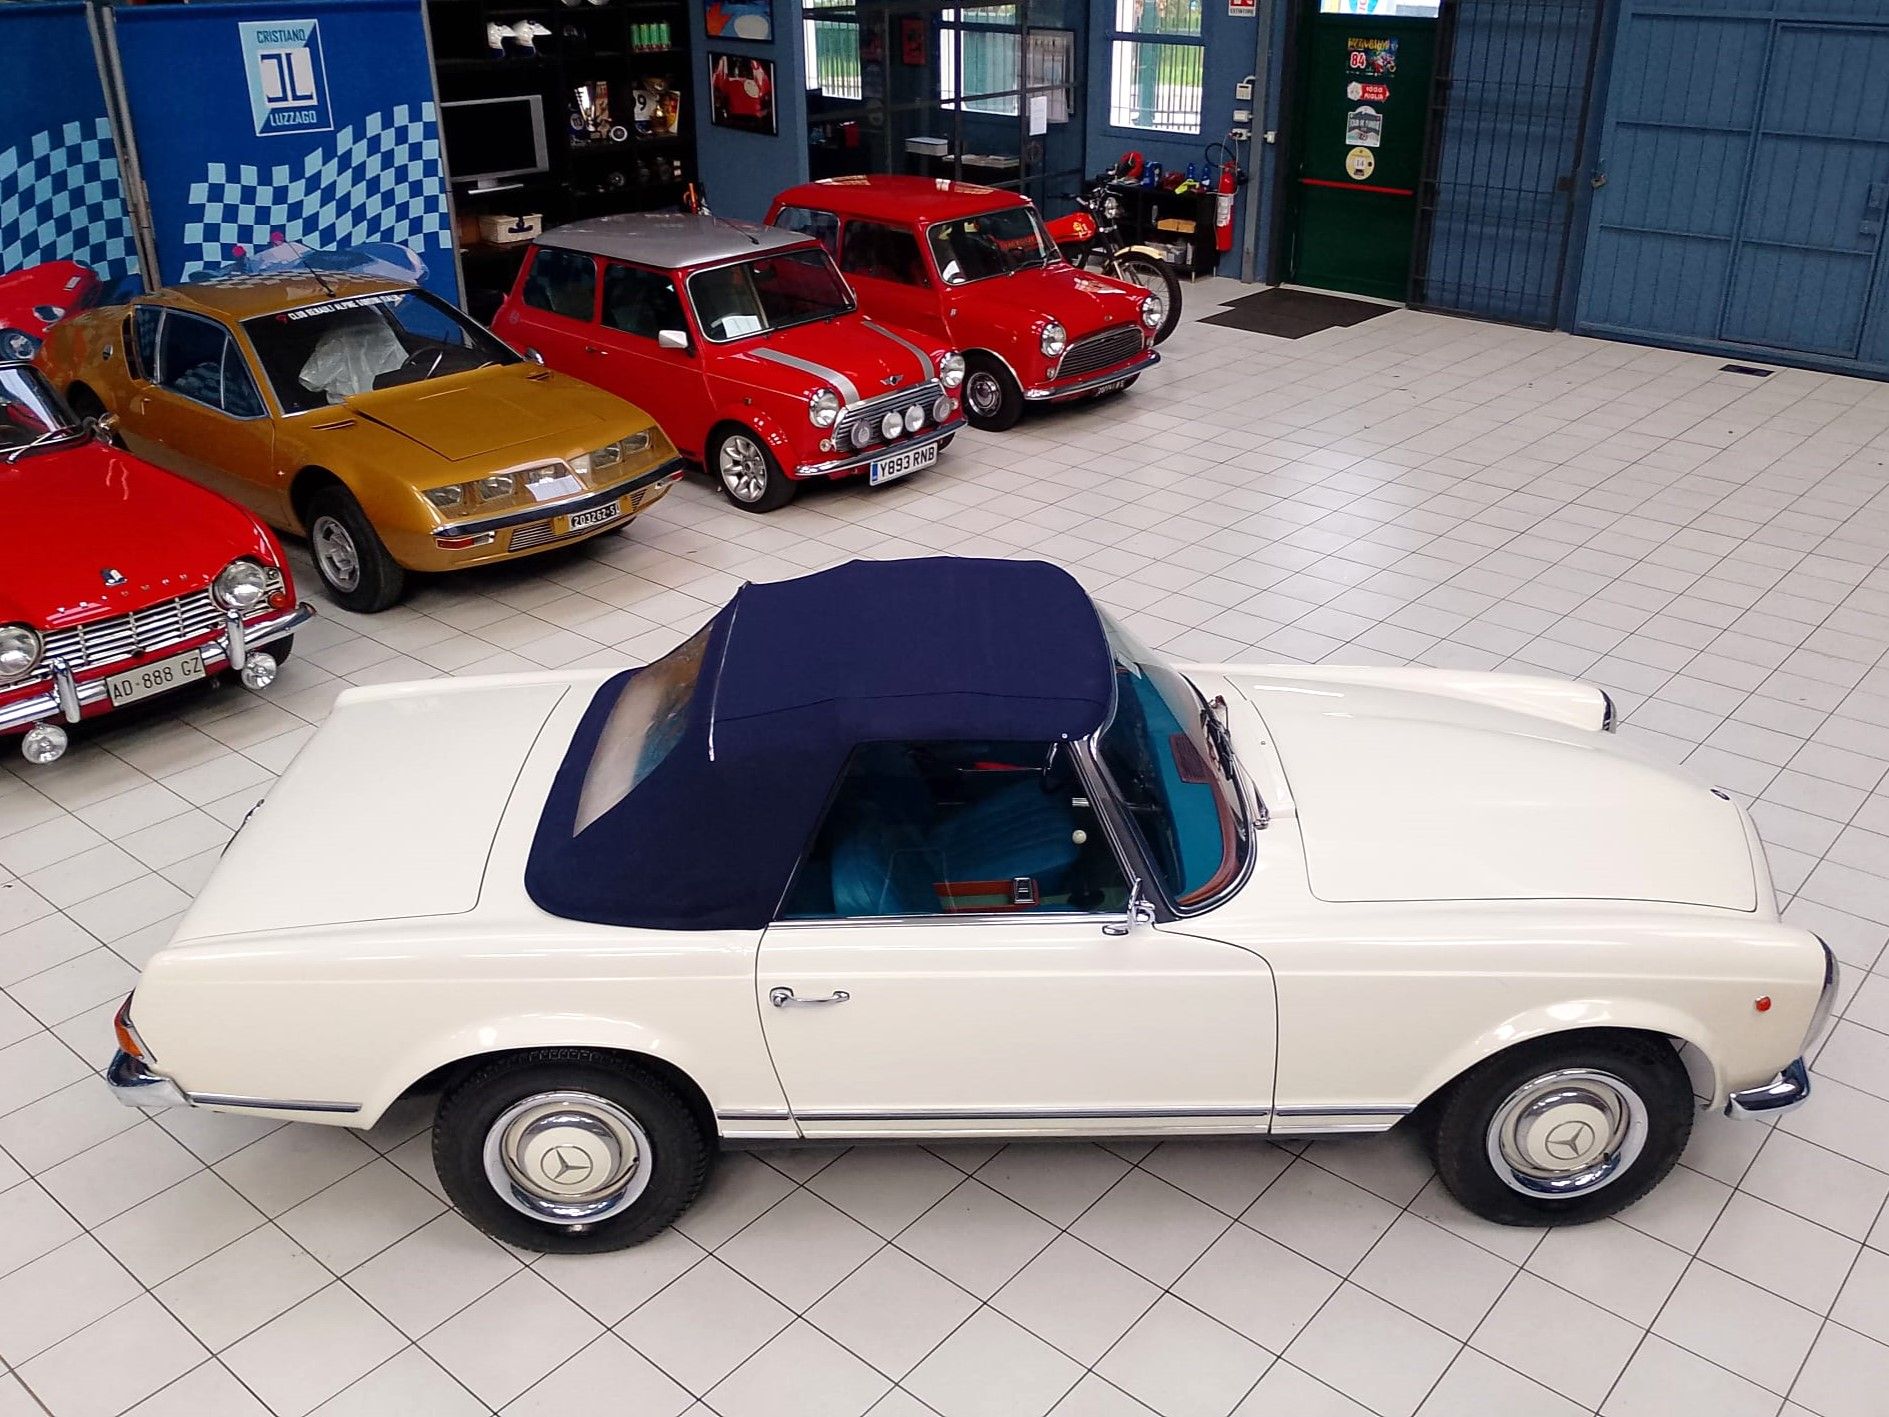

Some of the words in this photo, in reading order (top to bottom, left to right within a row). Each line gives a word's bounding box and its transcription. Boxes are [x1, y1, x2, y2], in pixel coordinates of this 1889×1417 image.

[256, 28, 306, 44] CRISTIANO
[1351, 52, 1366, 68] 84
[269, 110, 317, 126] LUZZAGO
[880, 455, 910, 477] Y893
[913, 446, 935, 466] RNB
[181, 656, 203, 677] GZ
